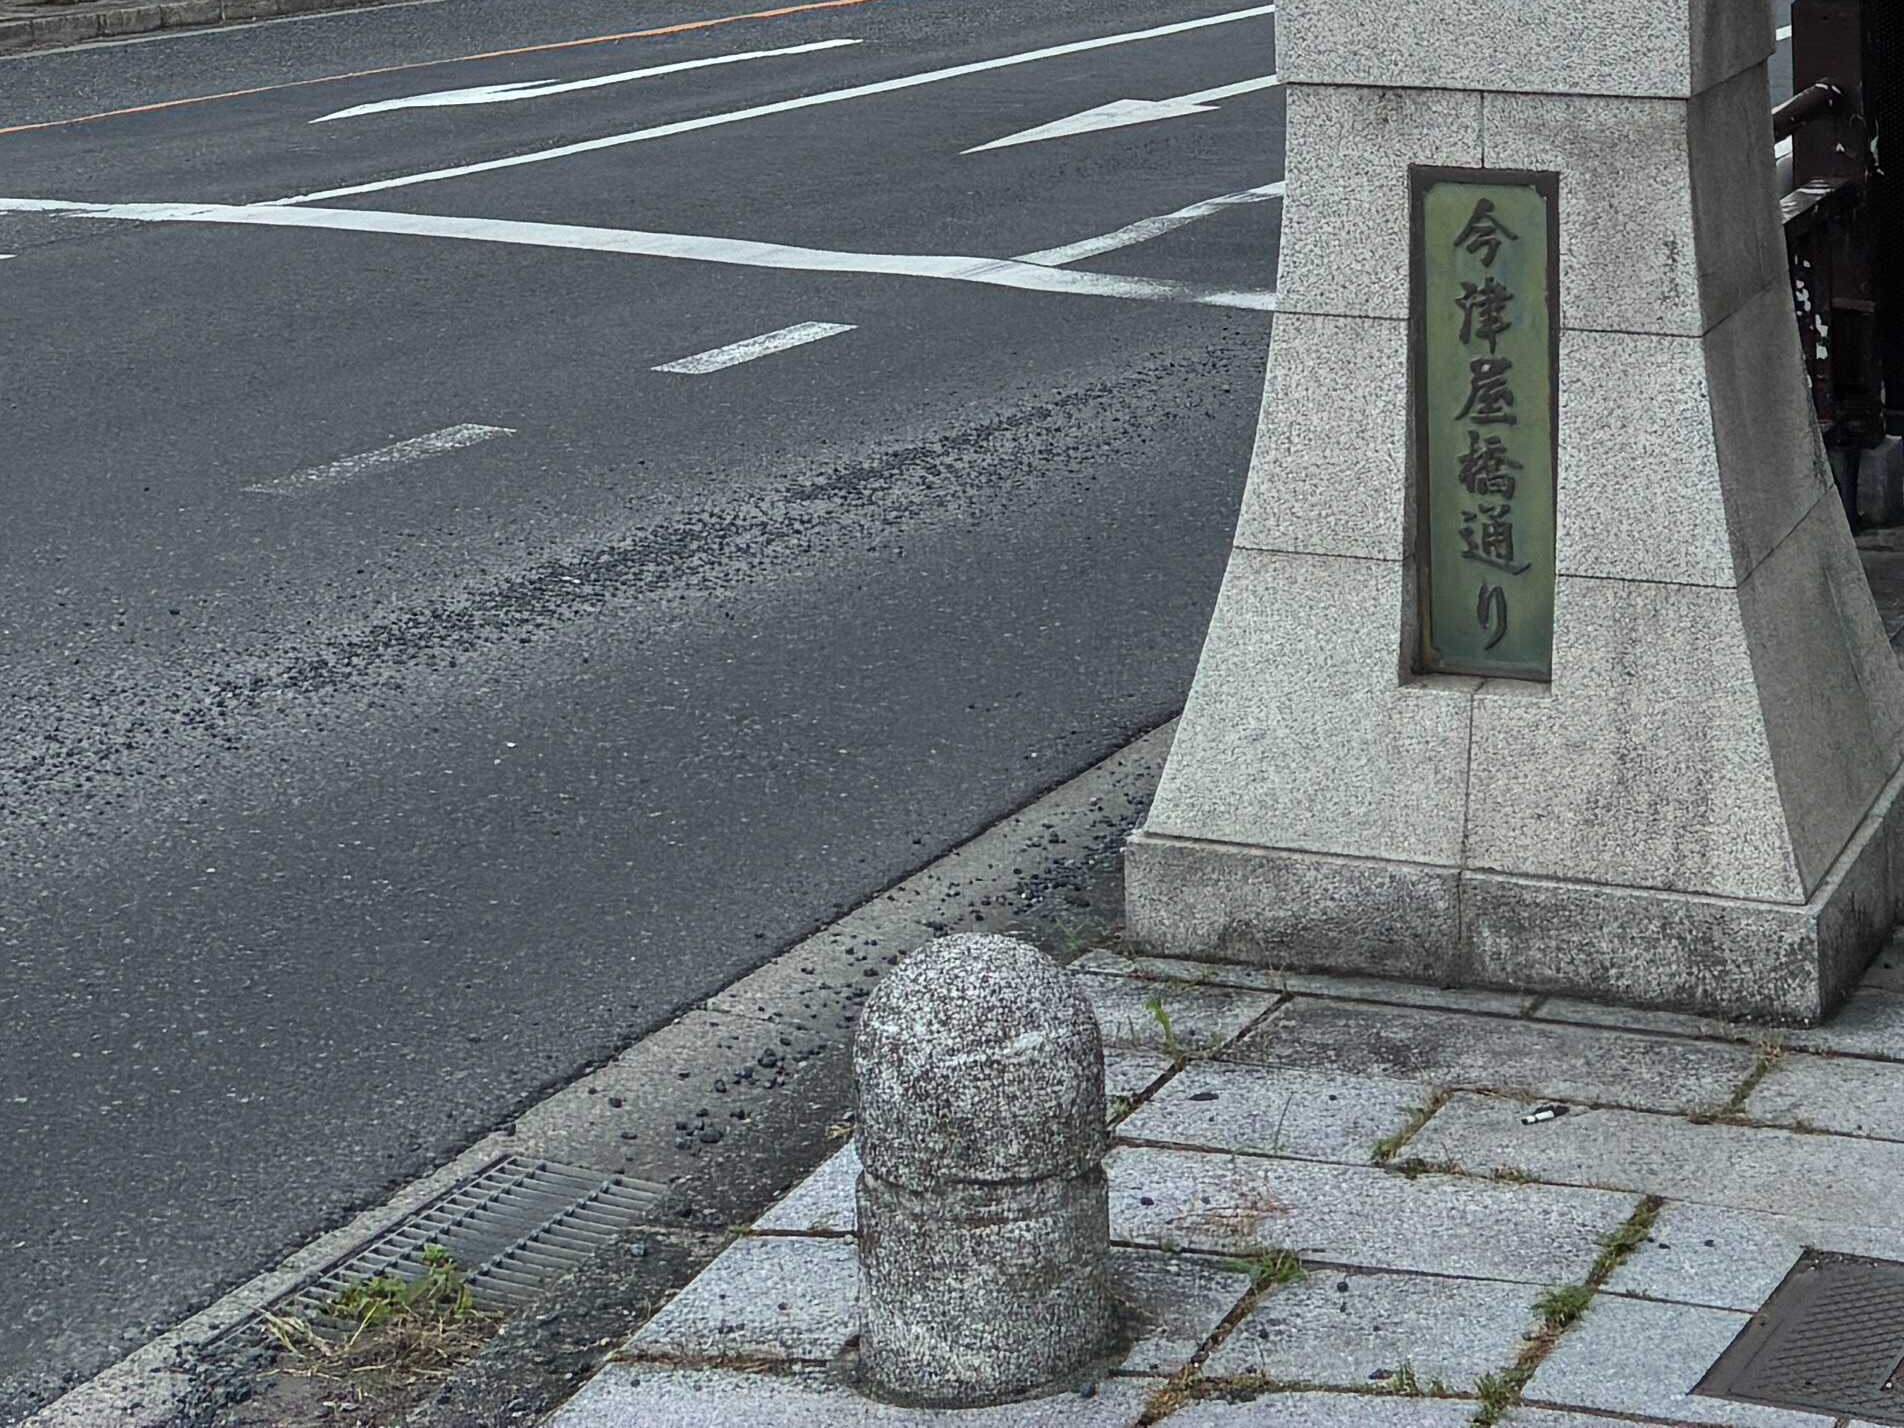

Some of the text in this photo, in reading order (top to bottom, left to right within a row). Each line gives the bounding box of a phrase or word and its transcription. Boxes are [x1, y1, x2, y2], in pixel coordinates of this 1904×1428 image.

[1453, 196, 1532, 651] 今津屋橋通り
